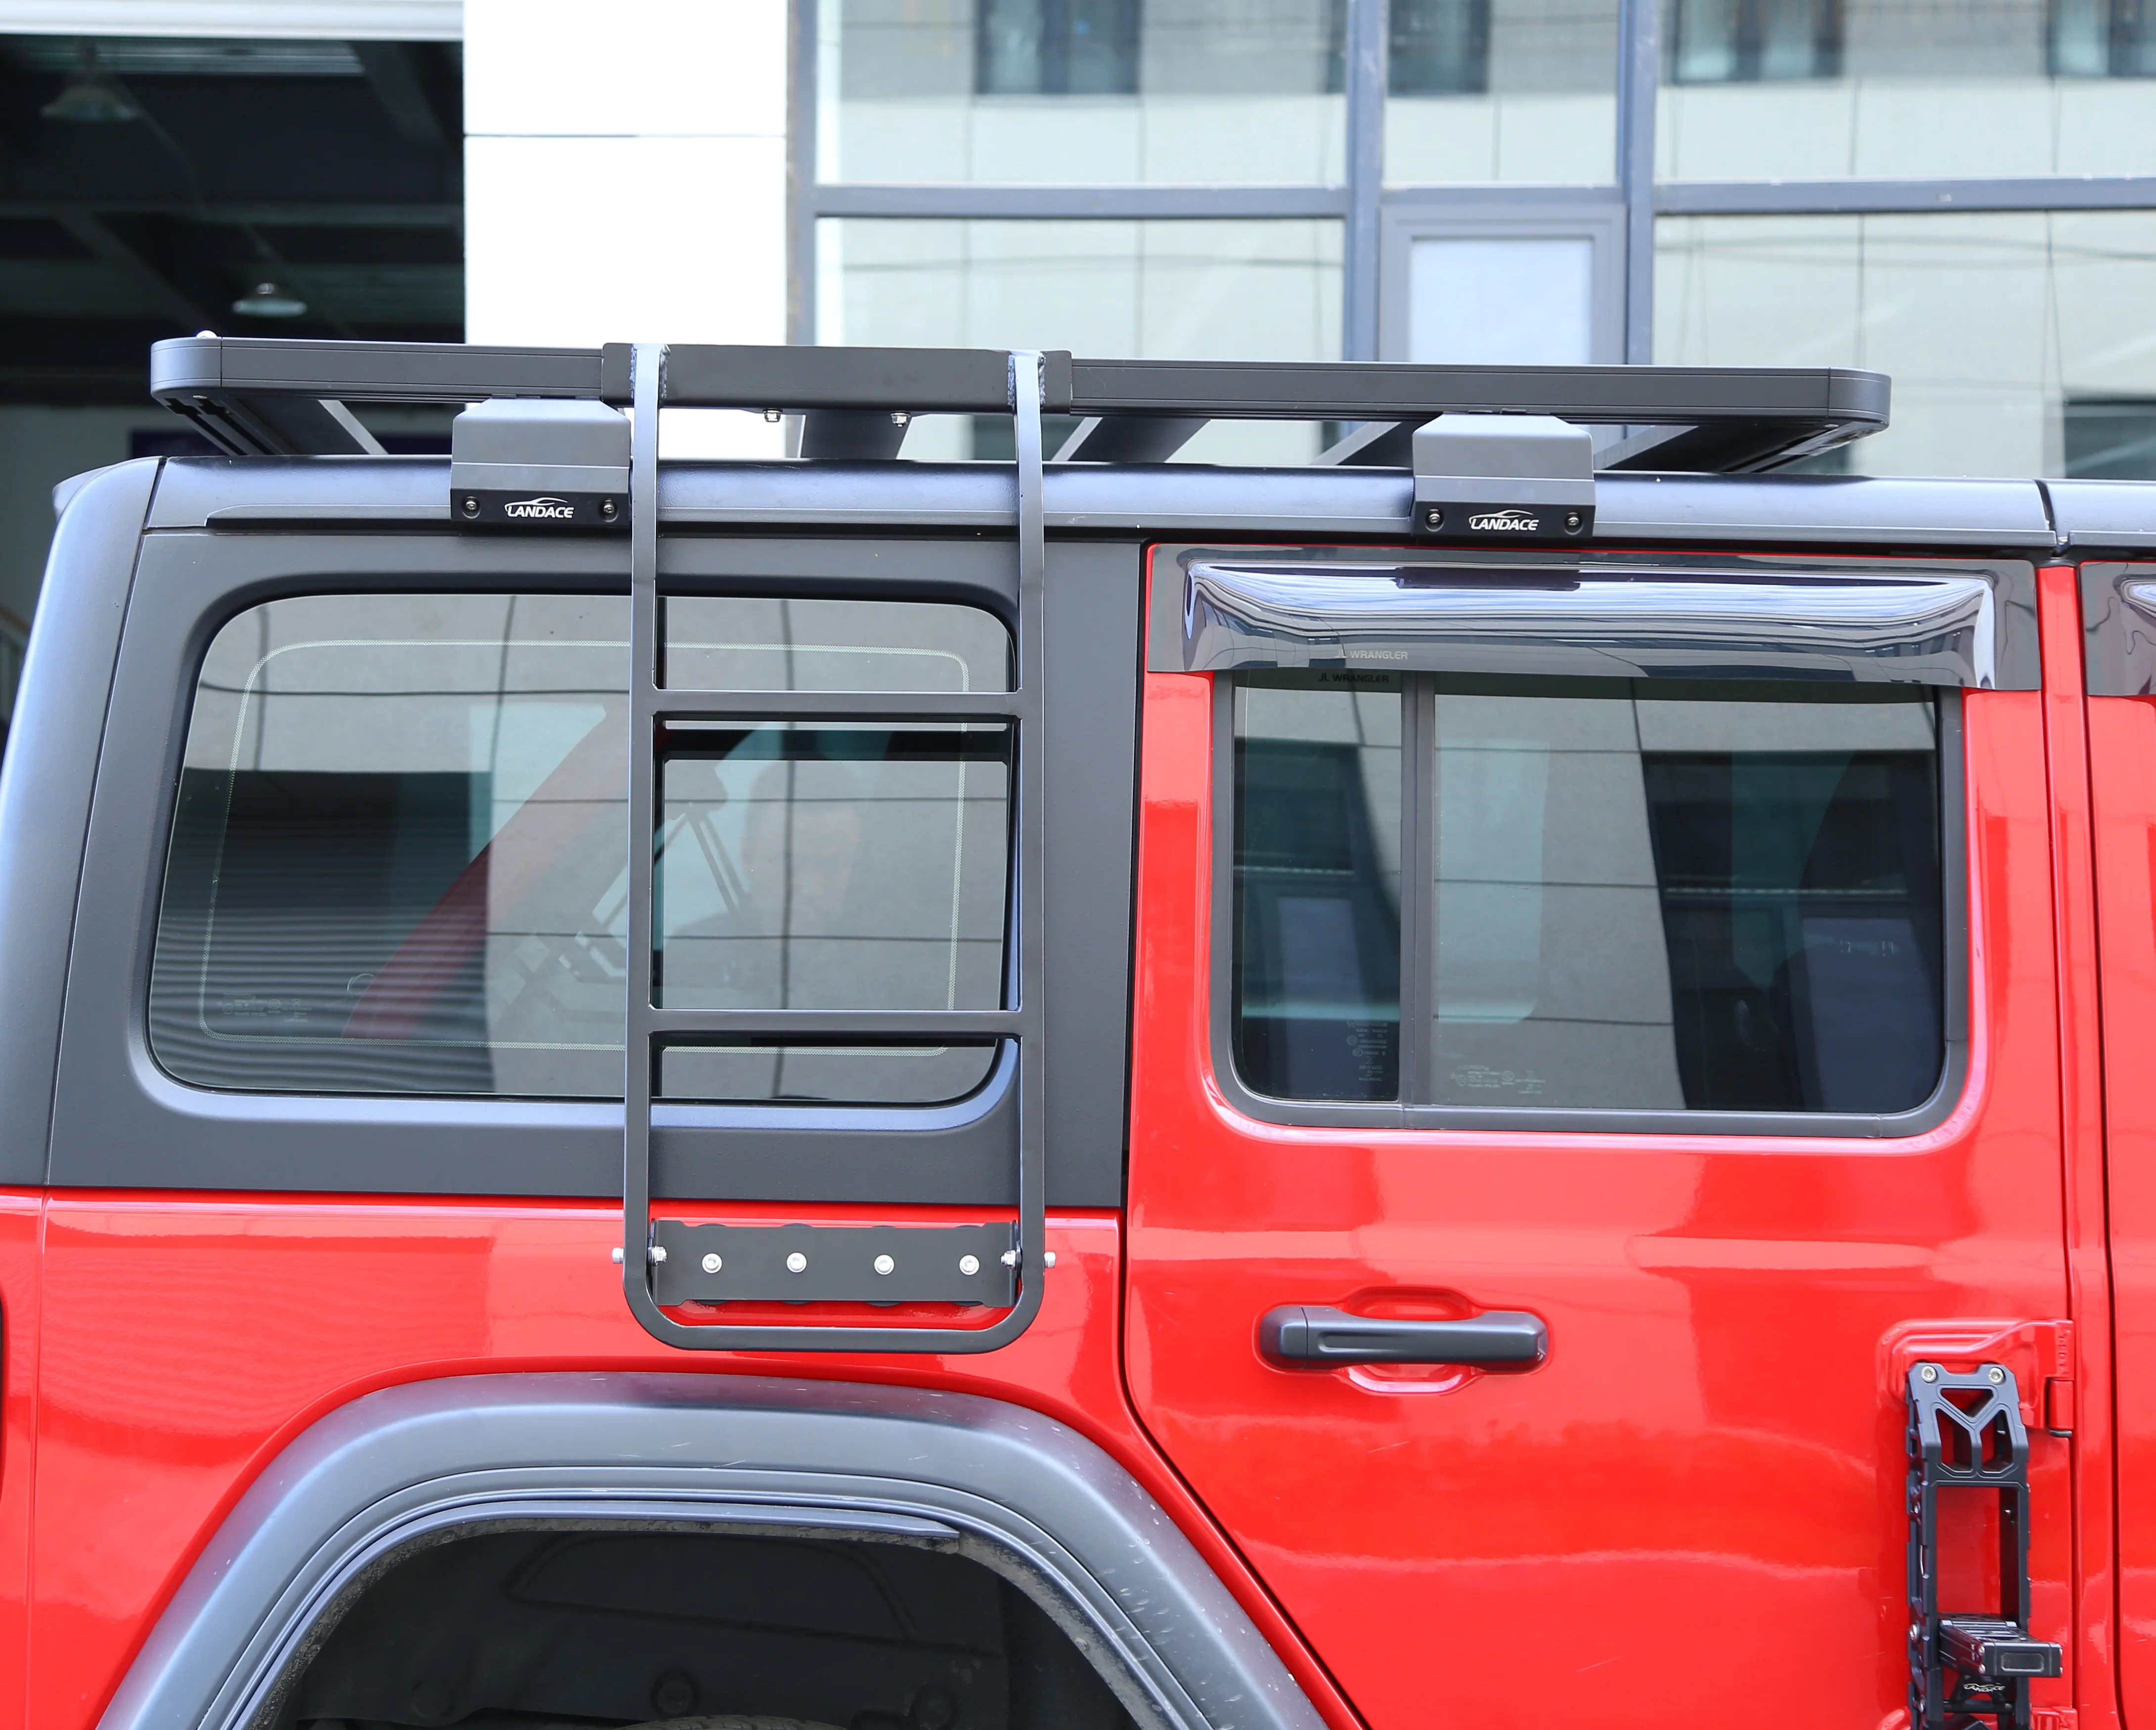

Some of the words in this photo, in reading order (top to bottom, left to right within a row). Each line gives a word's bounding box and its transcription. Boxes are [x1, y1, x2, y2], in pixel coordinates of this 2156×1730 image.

[507, 506, 574, 518] LANDACE
[1470, 518, 1539, 531] LANDACE
[1349, 651, 1408, 660] WRANGLER
[1318, 672, 1330, 682] JL
[1332, 673, 1389, 683] WRANGLER
